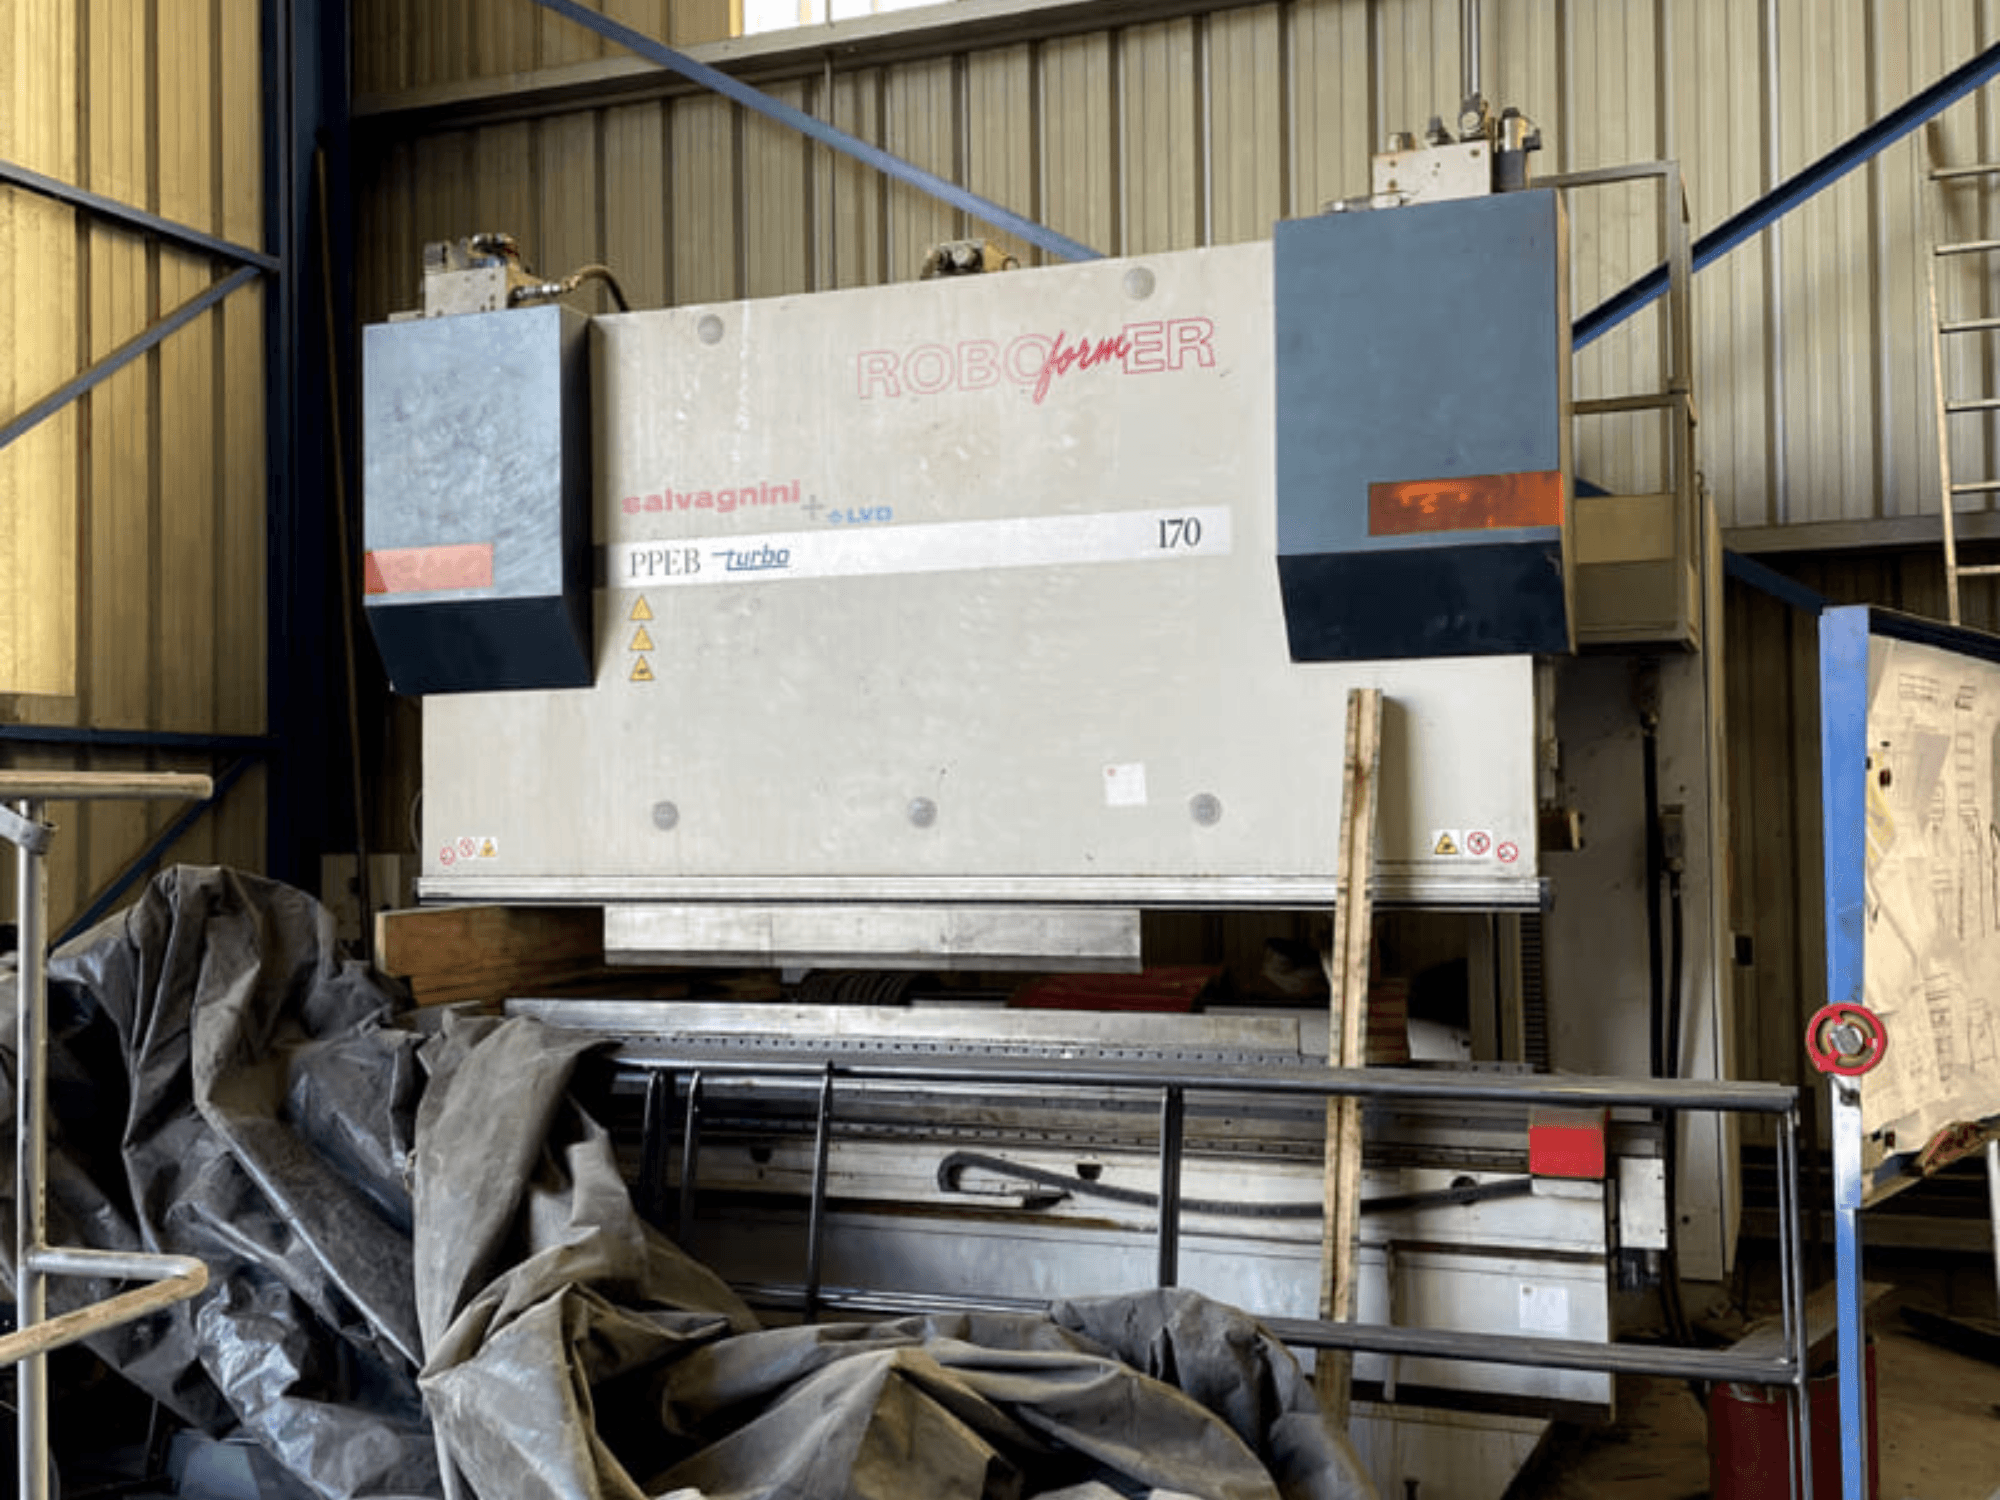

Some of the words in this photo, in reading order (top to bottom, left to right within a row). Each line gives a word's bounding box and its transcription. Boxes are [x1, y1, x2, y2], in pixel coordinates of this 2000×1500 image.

[622, 479, 801, 514] salvagnini
[630, 547, 701, 577] PPEB
[711, 543, 791, 571] turbo
[1159, 516, 1202, 549] 170
